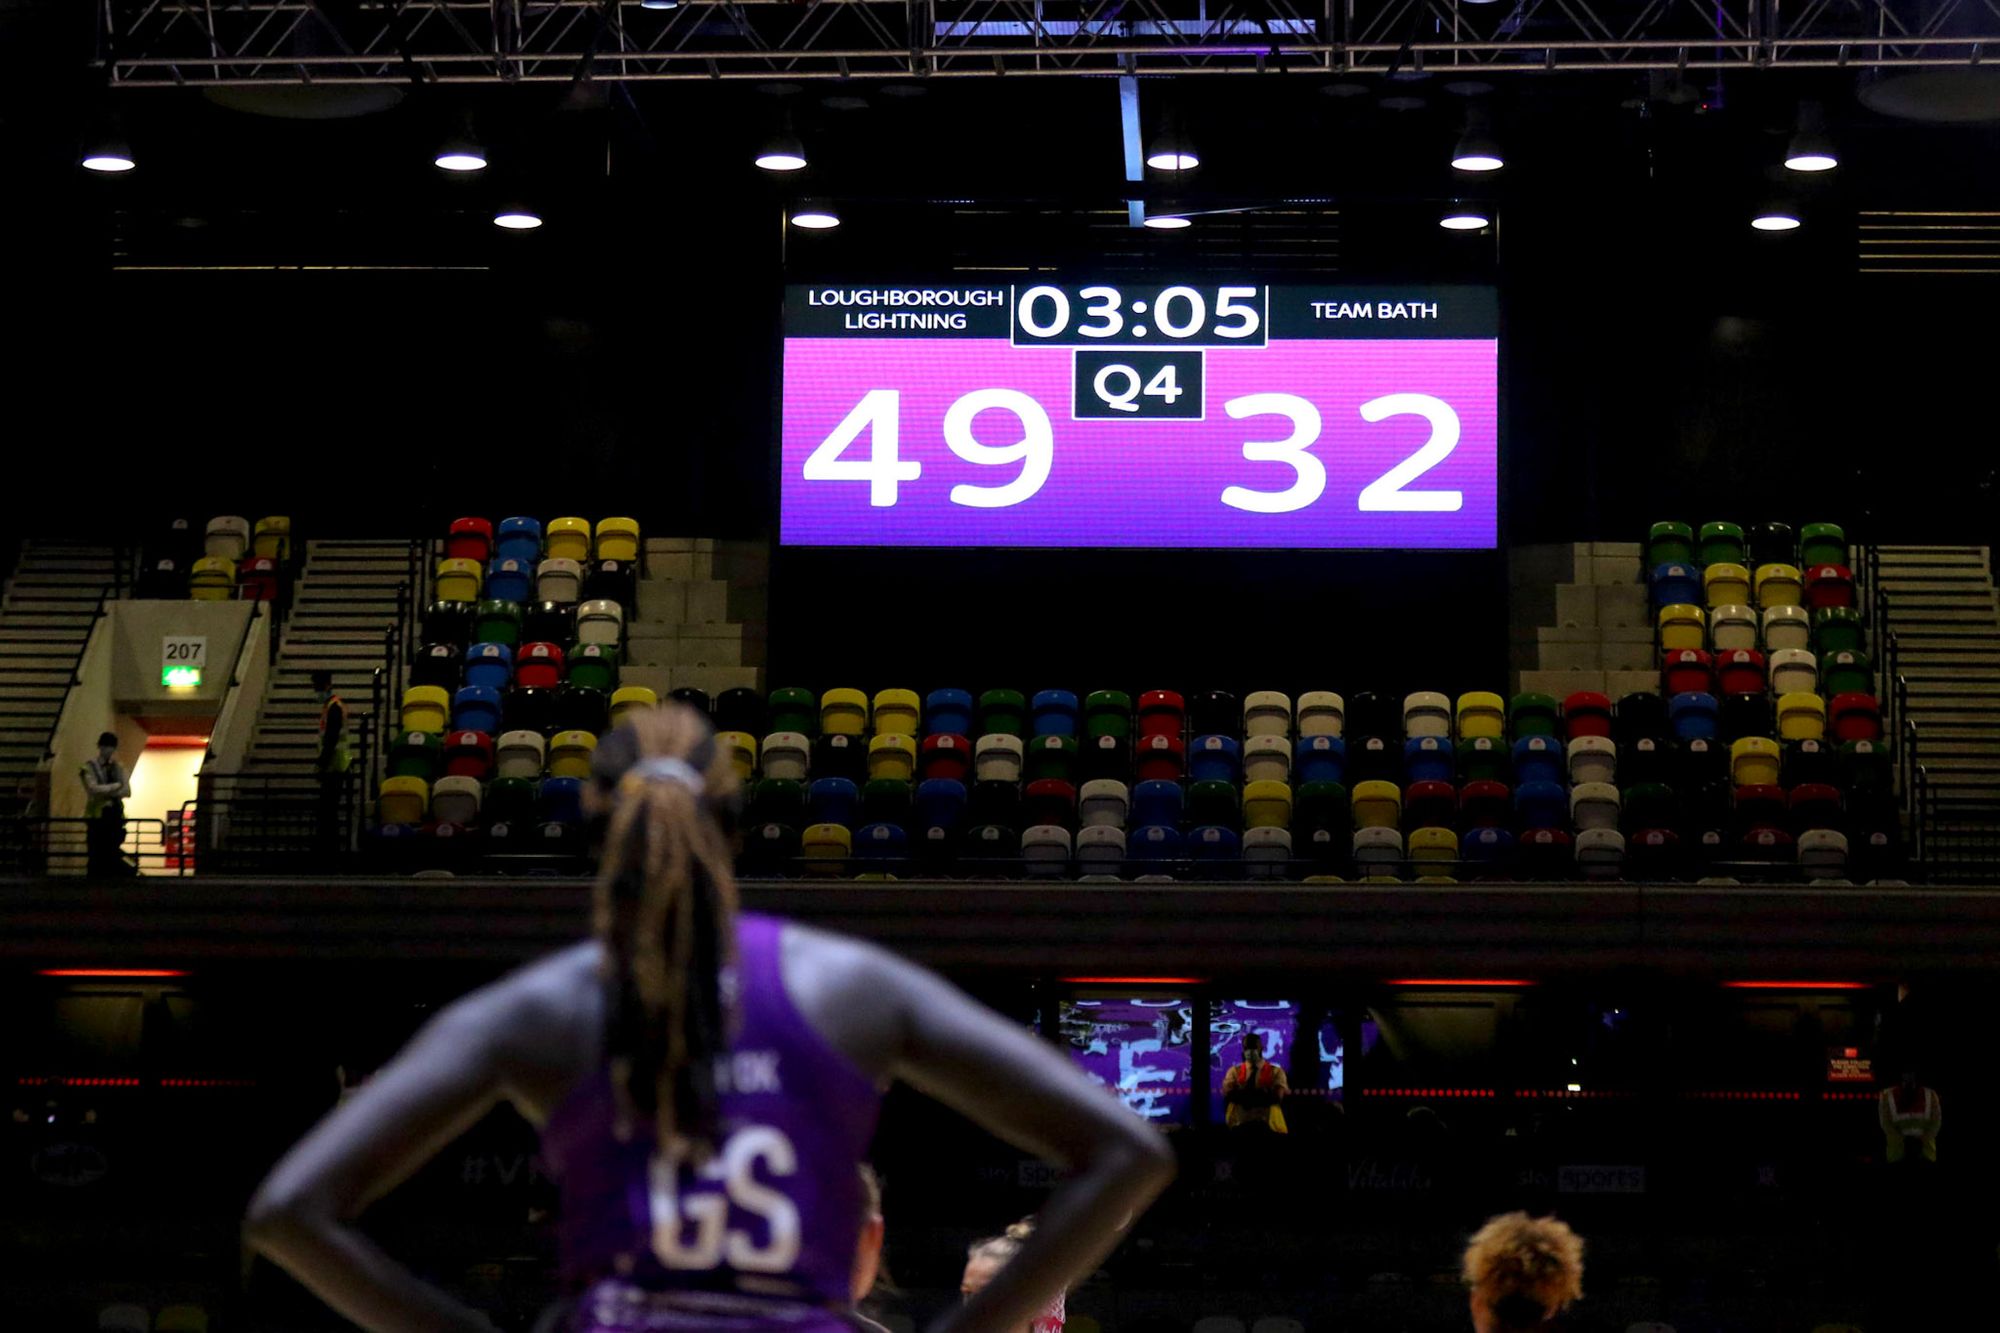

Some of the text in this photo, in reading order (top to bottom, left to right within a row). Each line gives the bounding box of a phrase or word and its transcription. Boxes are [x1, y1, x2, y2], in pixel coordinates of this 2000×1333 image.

[808, 289, 1004, 306] LOUGHBOROUGH
[1017, 285, 1260, 339] 03:05
[1310, 302, 1438, 319] TEAM BATH
[845, 312, 967, 330] LIGHTNING
[1093, 364, 1183, 412] Q4
[803, 388, 1054, 508] 49
[1221, 392, 1463, 513] 32
[167, 642, 202, 660] 207
[1561, 1168, 1642, 1190] sports
[647, 1122, 801, 1274] GS
